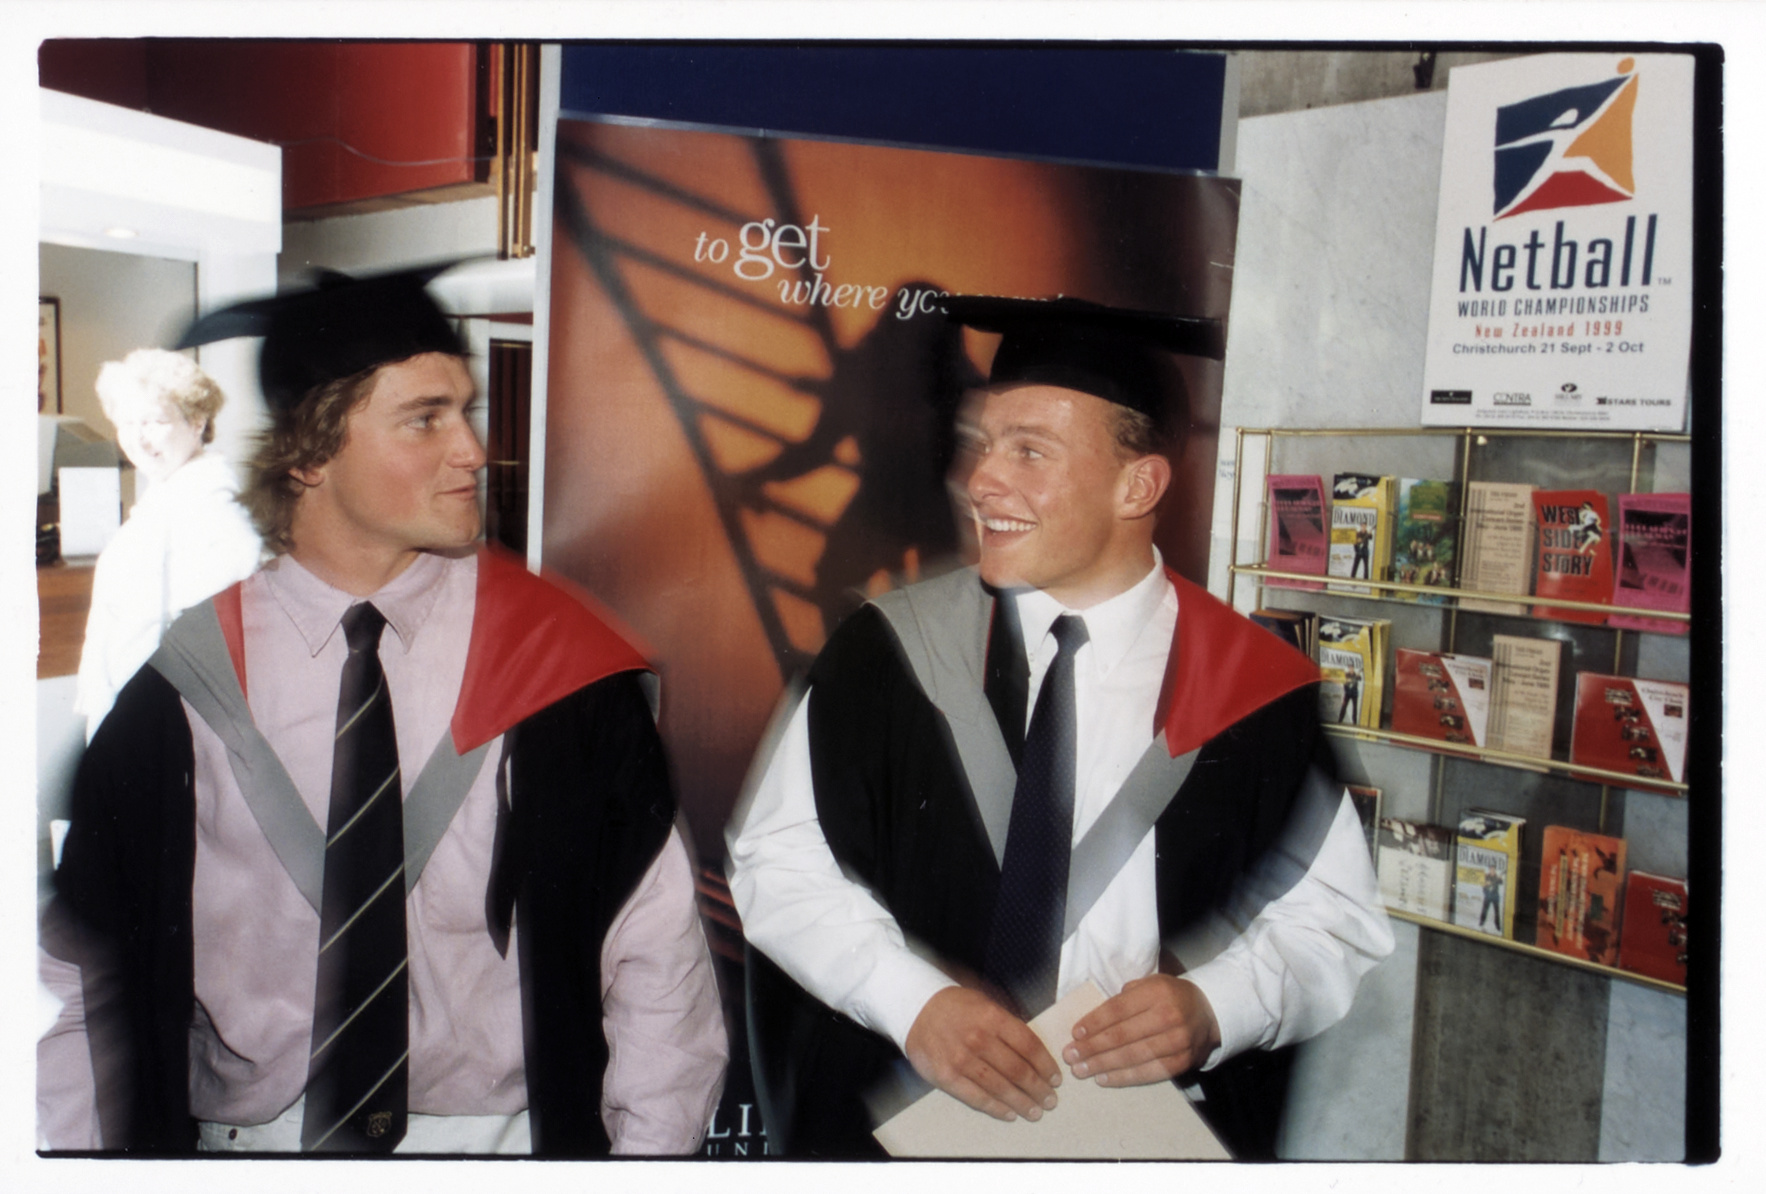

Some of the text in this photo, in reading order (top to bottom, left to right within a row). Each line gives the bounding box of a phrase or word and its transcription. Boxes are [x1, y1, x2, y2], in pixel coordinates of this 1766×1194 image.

[693, 213, 831, 281] to get
[1459, 213, 1658, 293] Netball
[777, 272, 888, 309] where
[1458, 294, 1650, 318] WORLD CHAMPIONSHIPS
[1475, 320, 1624, 338] New Zealand 1999
[1452, 342, 1537, 355] Christchurch
[1540, 342, 1556, 354] 21
[1561, 341, 1592, 356] Sept
[1605, 341, 1614, 353] 2
[1618, 340, 1645, 353] Oct
[1333, 508, 1376, 527] DIAMOND
[1542, 552, 1594, 577] STORY
[706, 1103, 767, 1138] LI
